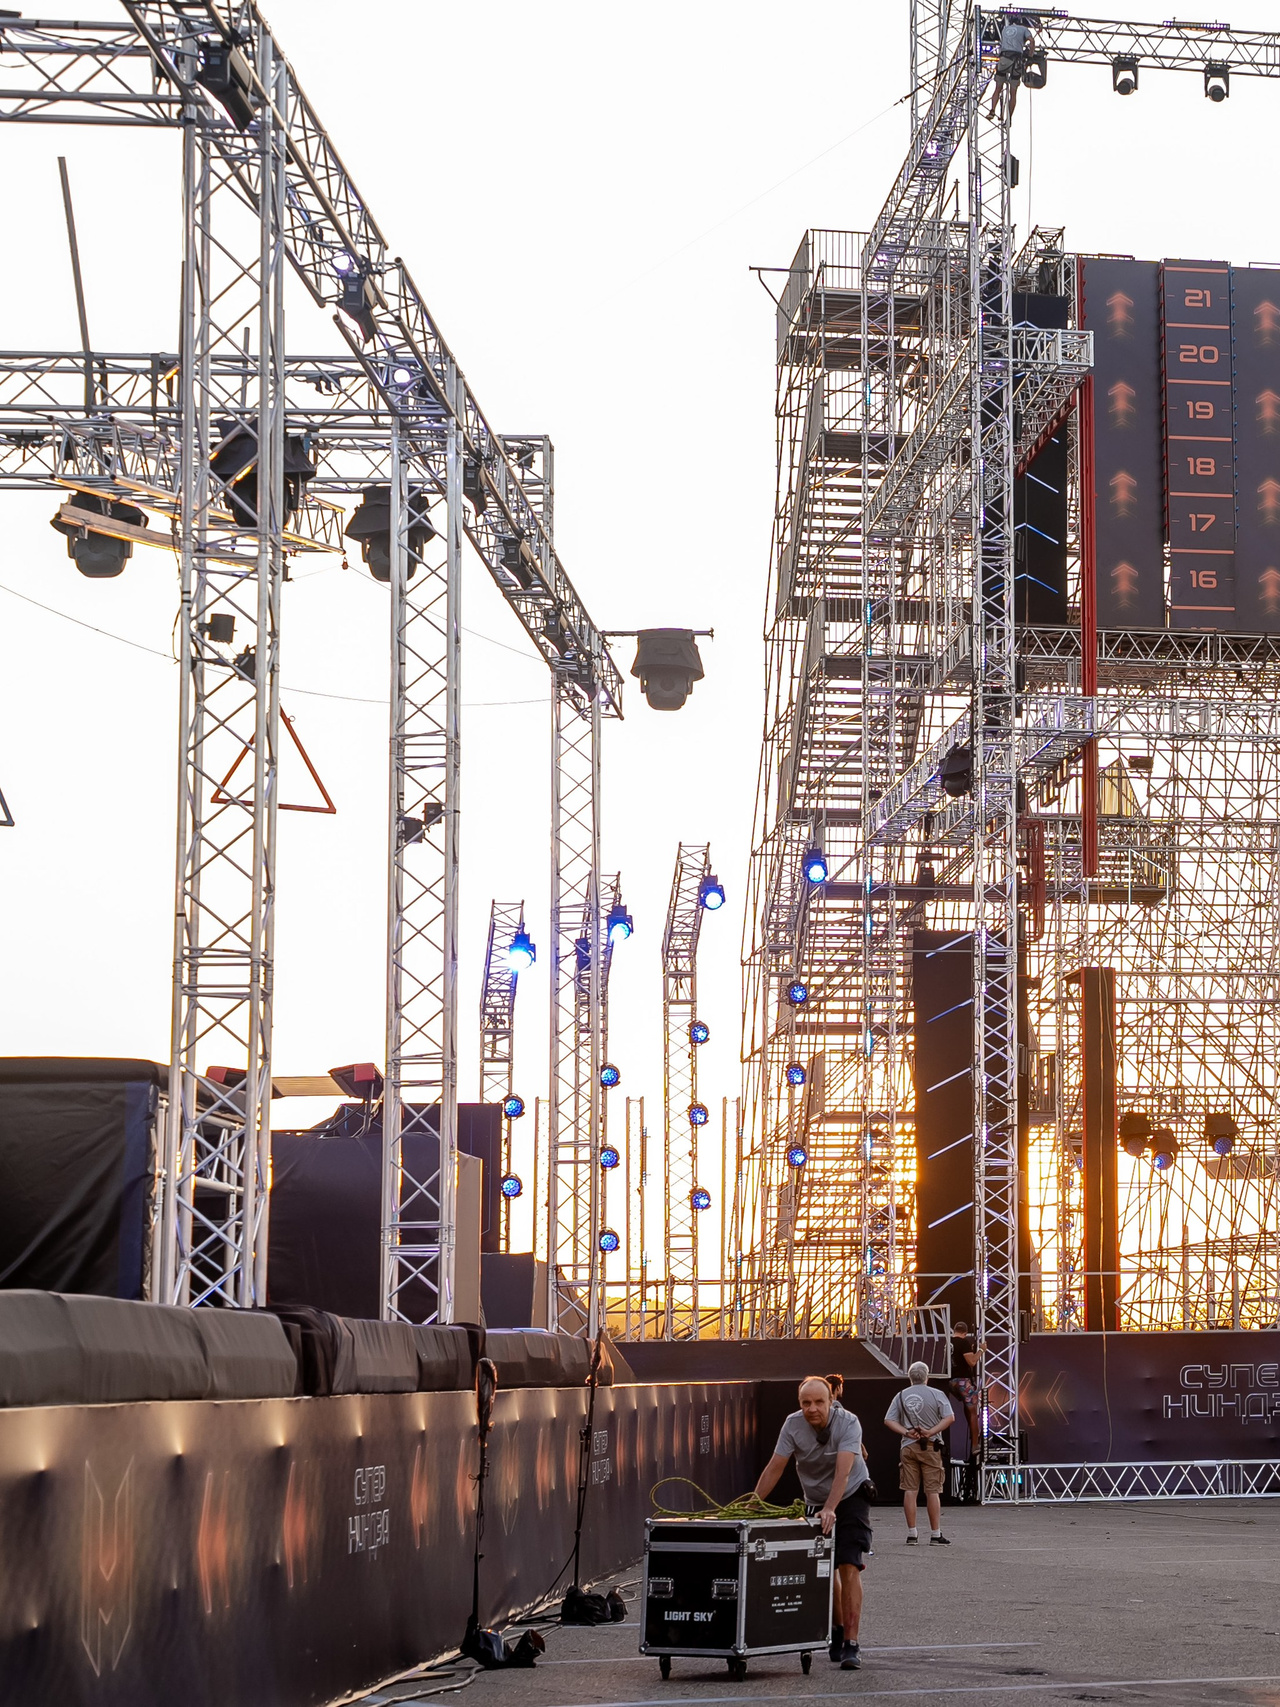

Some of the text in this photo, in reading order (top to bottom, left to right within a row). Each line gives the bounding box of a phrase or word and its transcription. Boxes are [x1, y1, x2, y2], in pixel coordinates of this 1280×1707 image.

[1184, 288, 1212, 308] 21
[1179, 344, 1219, 364] 20
[1186, 400, 1215, 420] 19
[1187, 456, 1216, 476] 18
[1188, 513, 1216, 533] 17
[1189, 569, 1218, 589] 16
[664, 1610, 714, 1622] LIGHT SKY
